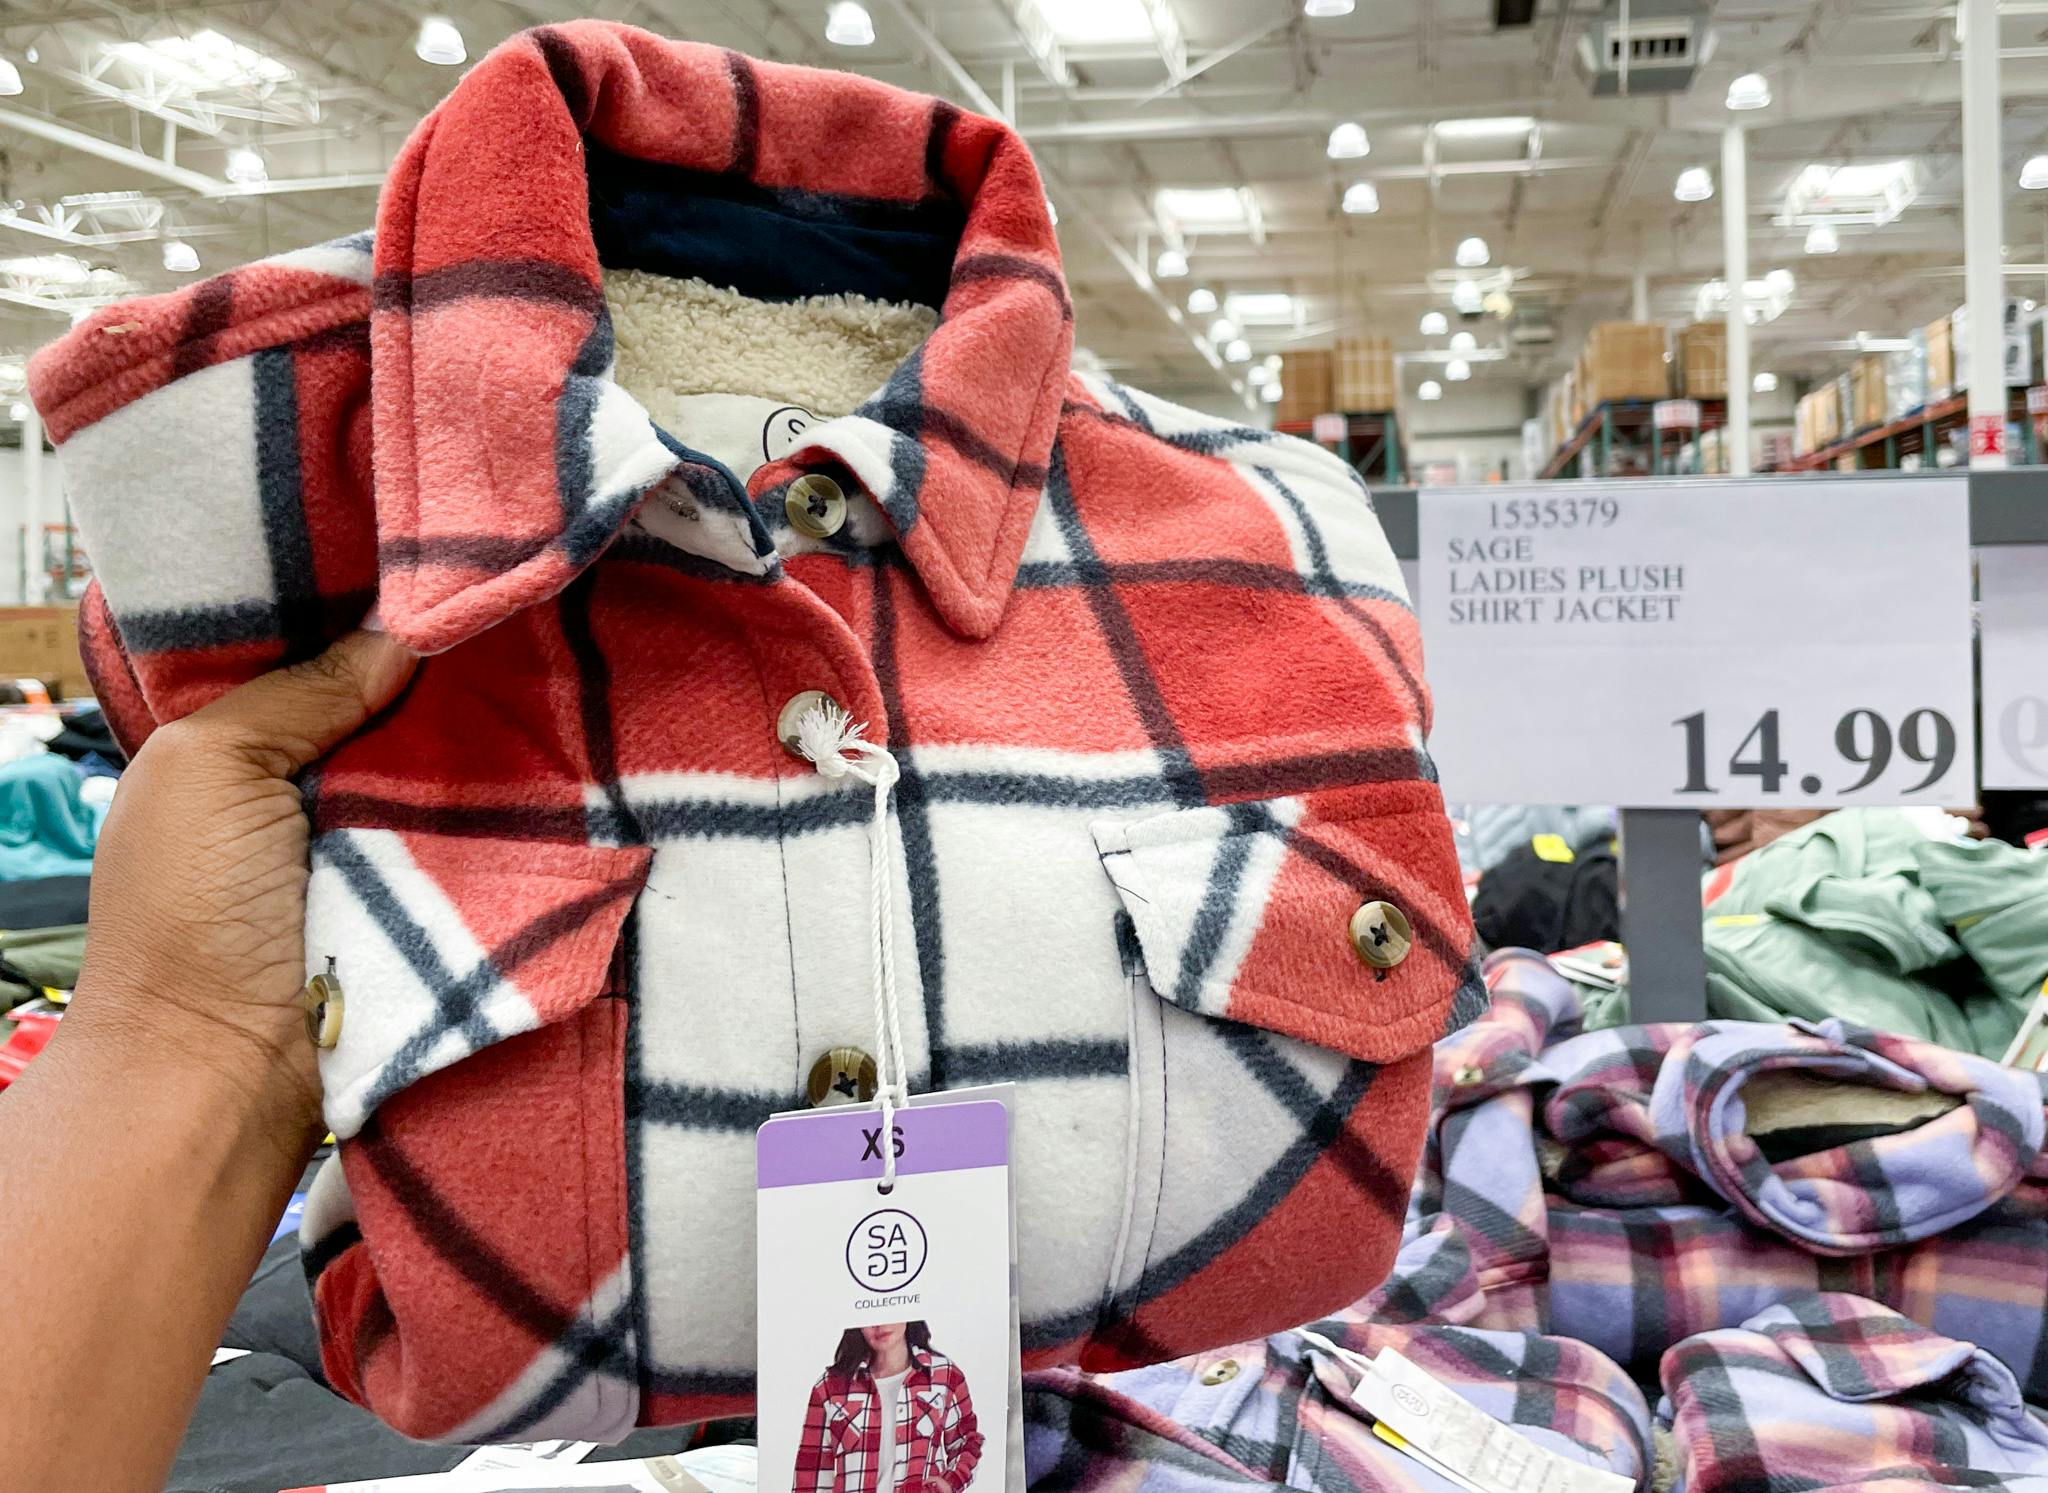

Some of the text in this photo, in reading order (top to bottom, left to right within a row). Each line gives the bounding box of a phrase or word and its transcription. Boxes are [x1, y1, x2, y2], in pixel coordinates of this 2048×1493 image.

[1490, 498, 1619, 529] 1535379
[1448, 536, 1533, 562] SAGE
[1450, 564, 1684, 594] LADIES PLUSH
[1449, 595, 1681, 624] SHIRT JACKET
[1672, 707, 1957, 795] 14.99
[860, 1126, 905, 1161] XS
[855, 1294, 921, 1309] COLLECTIVE
